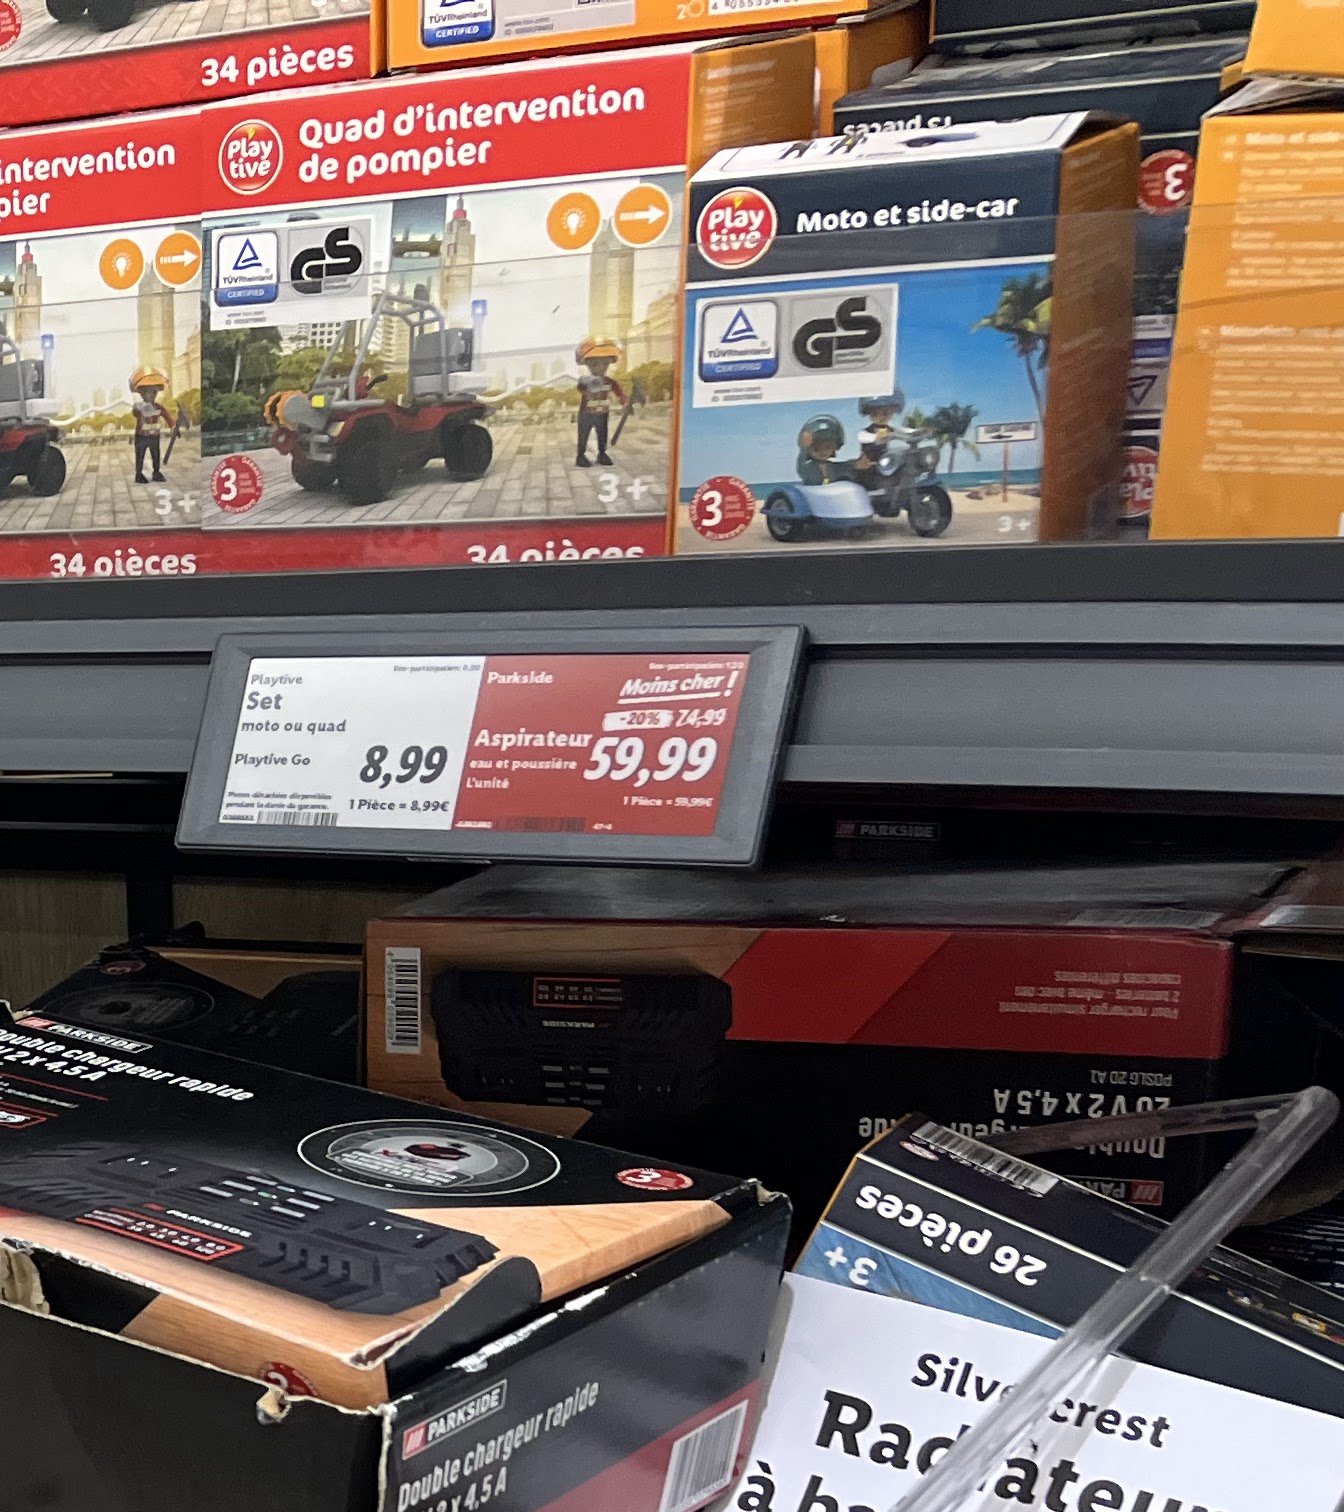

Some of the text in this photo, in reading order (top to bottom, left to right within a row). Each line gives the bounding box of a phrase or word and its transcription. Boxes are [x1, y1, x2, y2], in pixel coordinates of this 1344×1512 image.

[201, 44, 353, 86] 34 pièces
[299, 84, 645, 149] Quad d’intervention
[299, 137, 491, 184] de pompier
[708, 208, 764, 235] Play
[797, 198, 1019, 233] Moto et side-car
[251, 674, 303, 687] Playtive
[488, 672, 553, 683] Parkside
[247, 692, 283, 710] Set
[241, 720, 346, 734] moto ou quad
[475, 728, 593, 750] Aspirateur
[235, 754, 310, 767] Playtive Go
[360, 745, 448, 789] 8,99
[466, 737, 718, 789] L'unité 59,99
[470, 758, 577, 771] eau et poussière
[67, 1047, 173, 1084] chargeur
[167, 1067, 254, 1102] rapide
[855, 1184, 1049, 1287] 26 pièces
[428, 1387, 501, 1441] PARKSIDE
[397, 1382, 599, 1512] Double chargeur rapide
